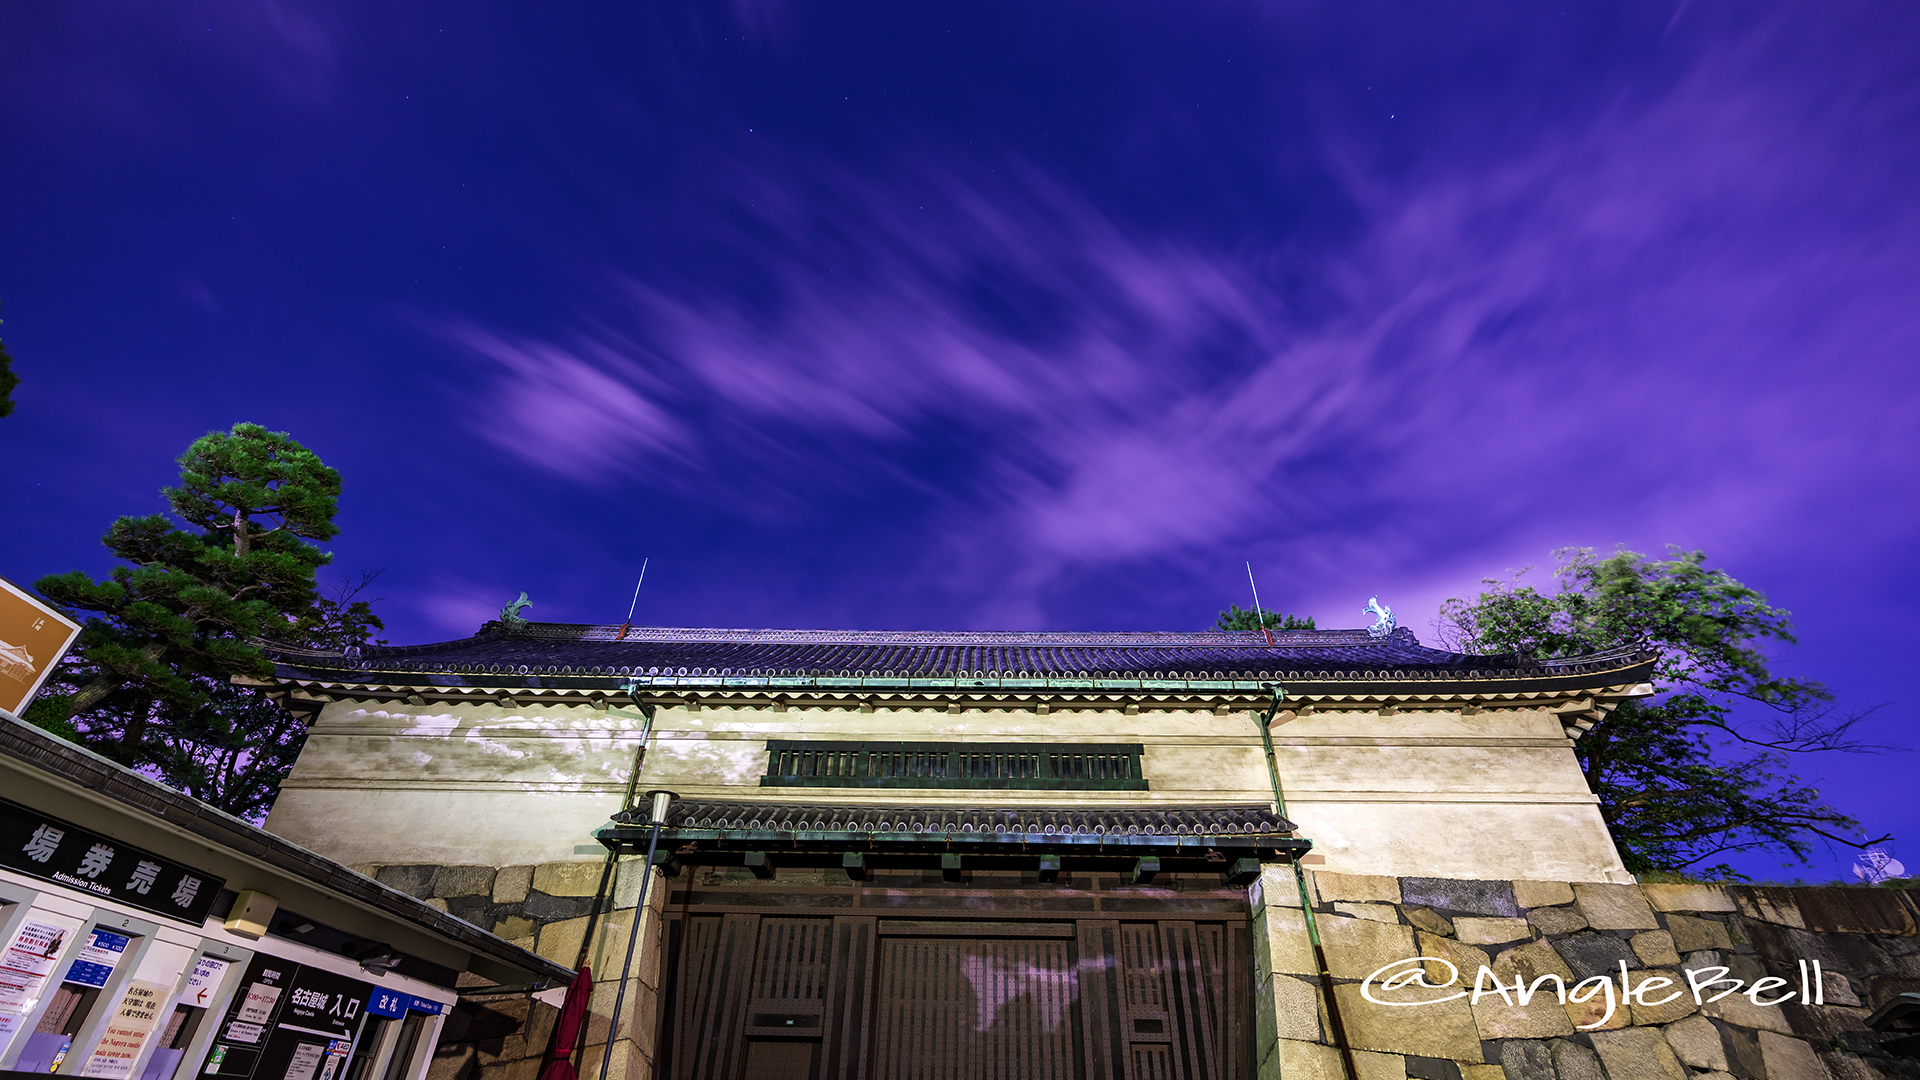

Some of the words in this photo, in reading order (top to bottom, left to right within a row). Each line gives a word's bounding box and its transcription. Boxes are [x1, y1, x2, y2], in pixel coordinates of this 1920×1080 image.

[52, 871, 88, 888] Admission
[88, 881, 111, 895] Tickets
[122, 919, 129, 927] 2
[223, 946, 229, 954] 3
[128, 987, 153, 997] 名古屋城の
[292, 987, 329, 1010] 名古屋城
[329, 994, 360, 1020] 入口
[379, 995, 398, 1012] 改札
[120, 1009, 154, 1020] 入場できません
[117, 1028, 132, 1036] cannot
[109, 1039, 126, 1048] Nagoya
[107, 1050, 121, 1058] tower
